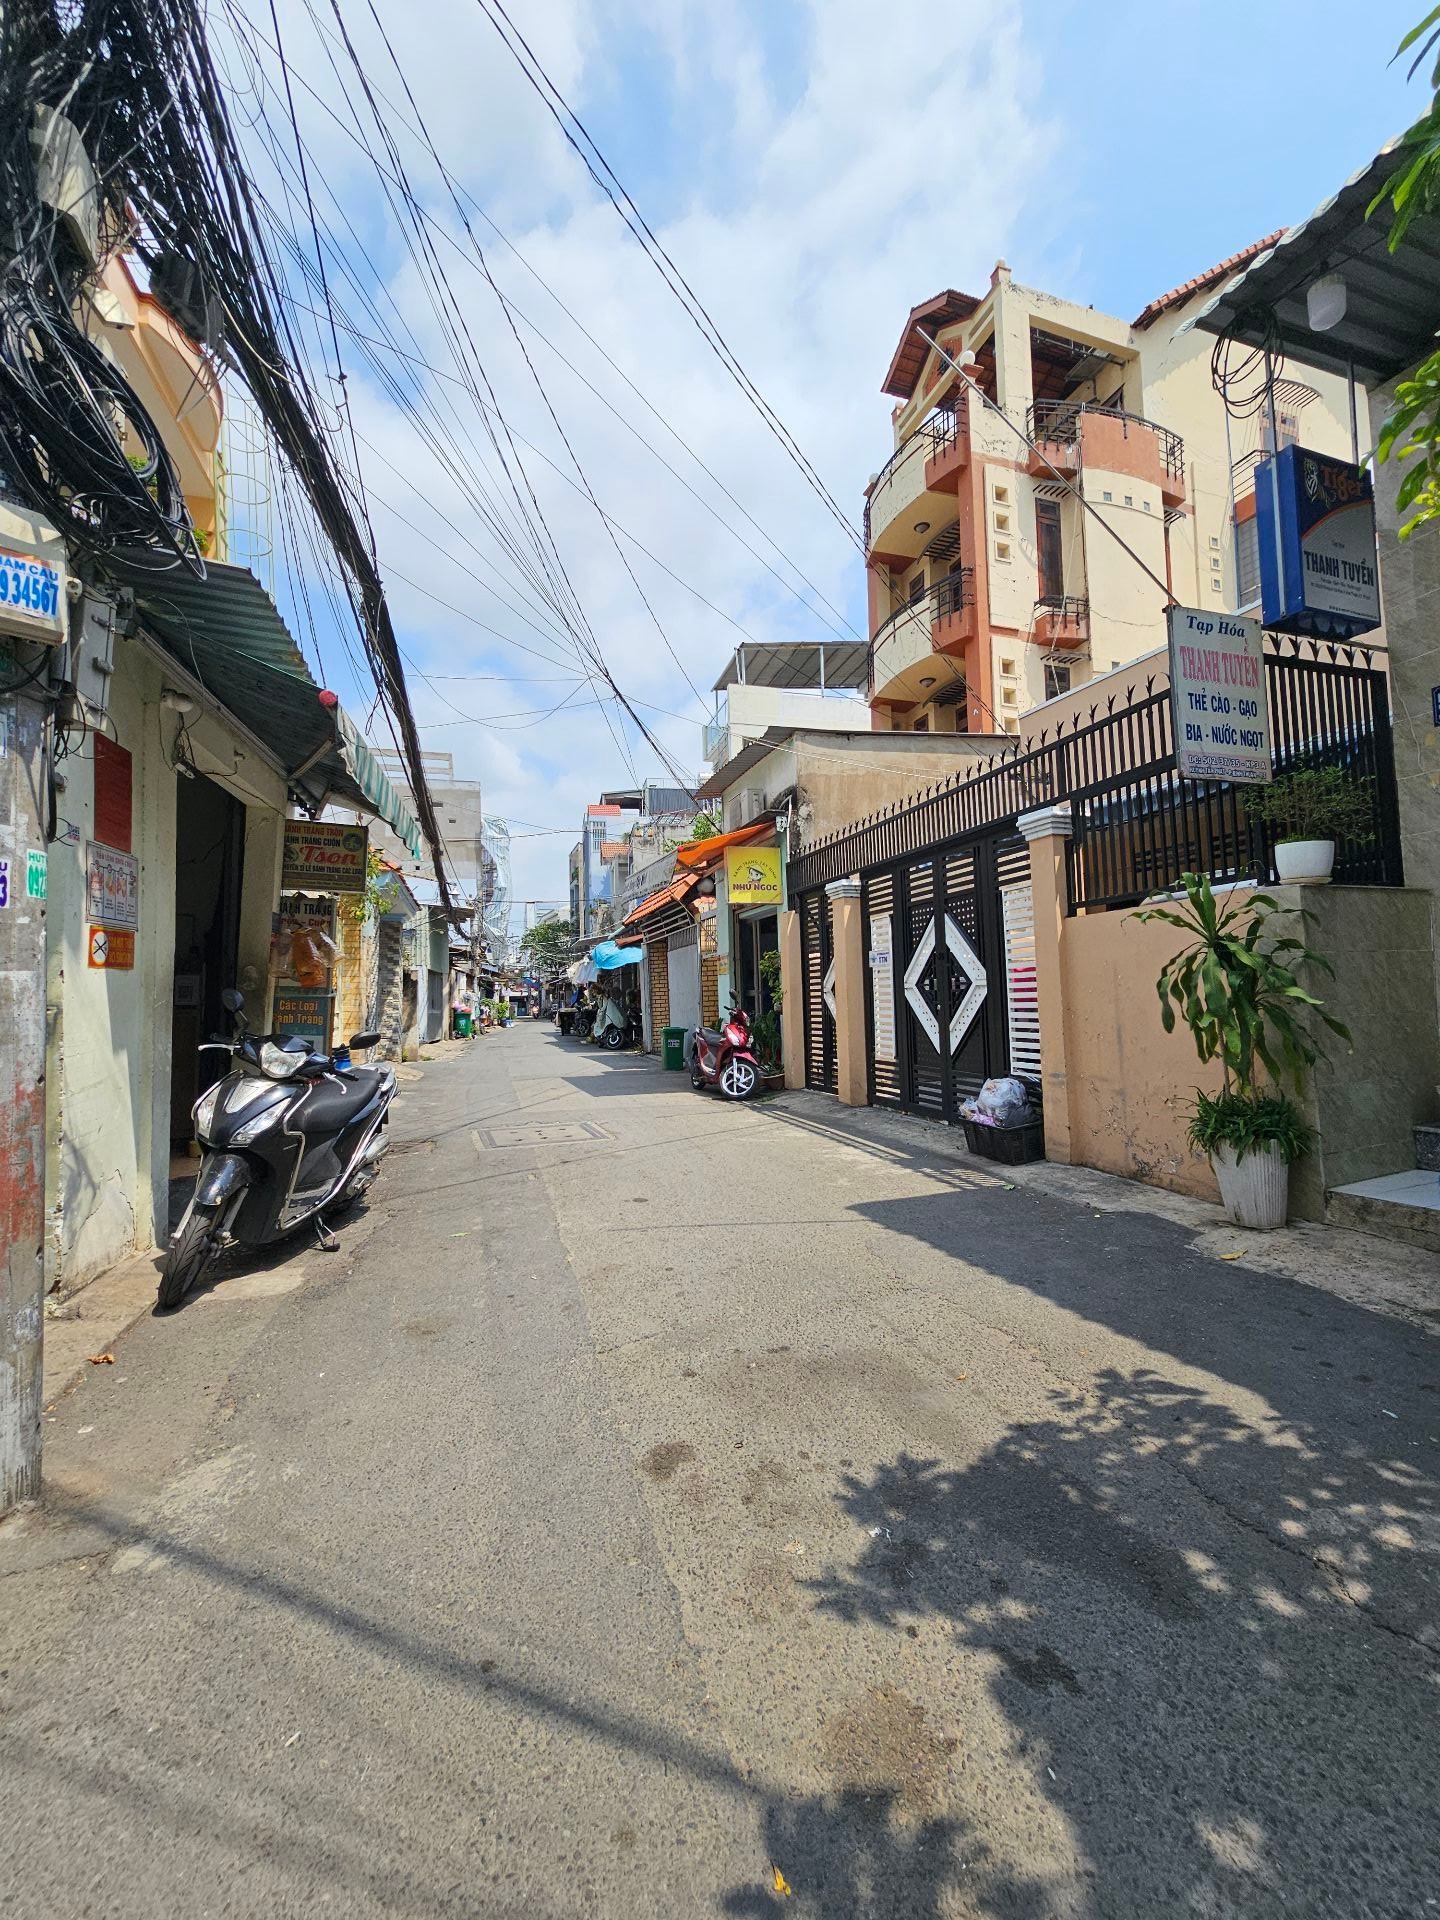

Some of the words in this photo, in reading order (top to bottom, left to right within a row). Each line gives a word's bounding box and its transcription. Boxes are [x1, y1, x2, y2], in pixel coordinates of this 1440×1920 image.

[1304, 551, 1340, 578] THANH
[1186, 615, 1214, 636] Tạp
[1218, 620, 1246, 638] Hóa
[1179, 645, 1221, 684] THANH
[1188, 687, 1208, 711] THẺ
[1211, 691, 1231, 714] CÀO
[1239, 699, 1258, 720] GẠO
[1185, 723, 1203, 742] BIA
[1211, 723, 1238, 746] NƯỚC
[1240, 730, 1264, 752] NGỌT
[279, 999, 297, 1010] Các
